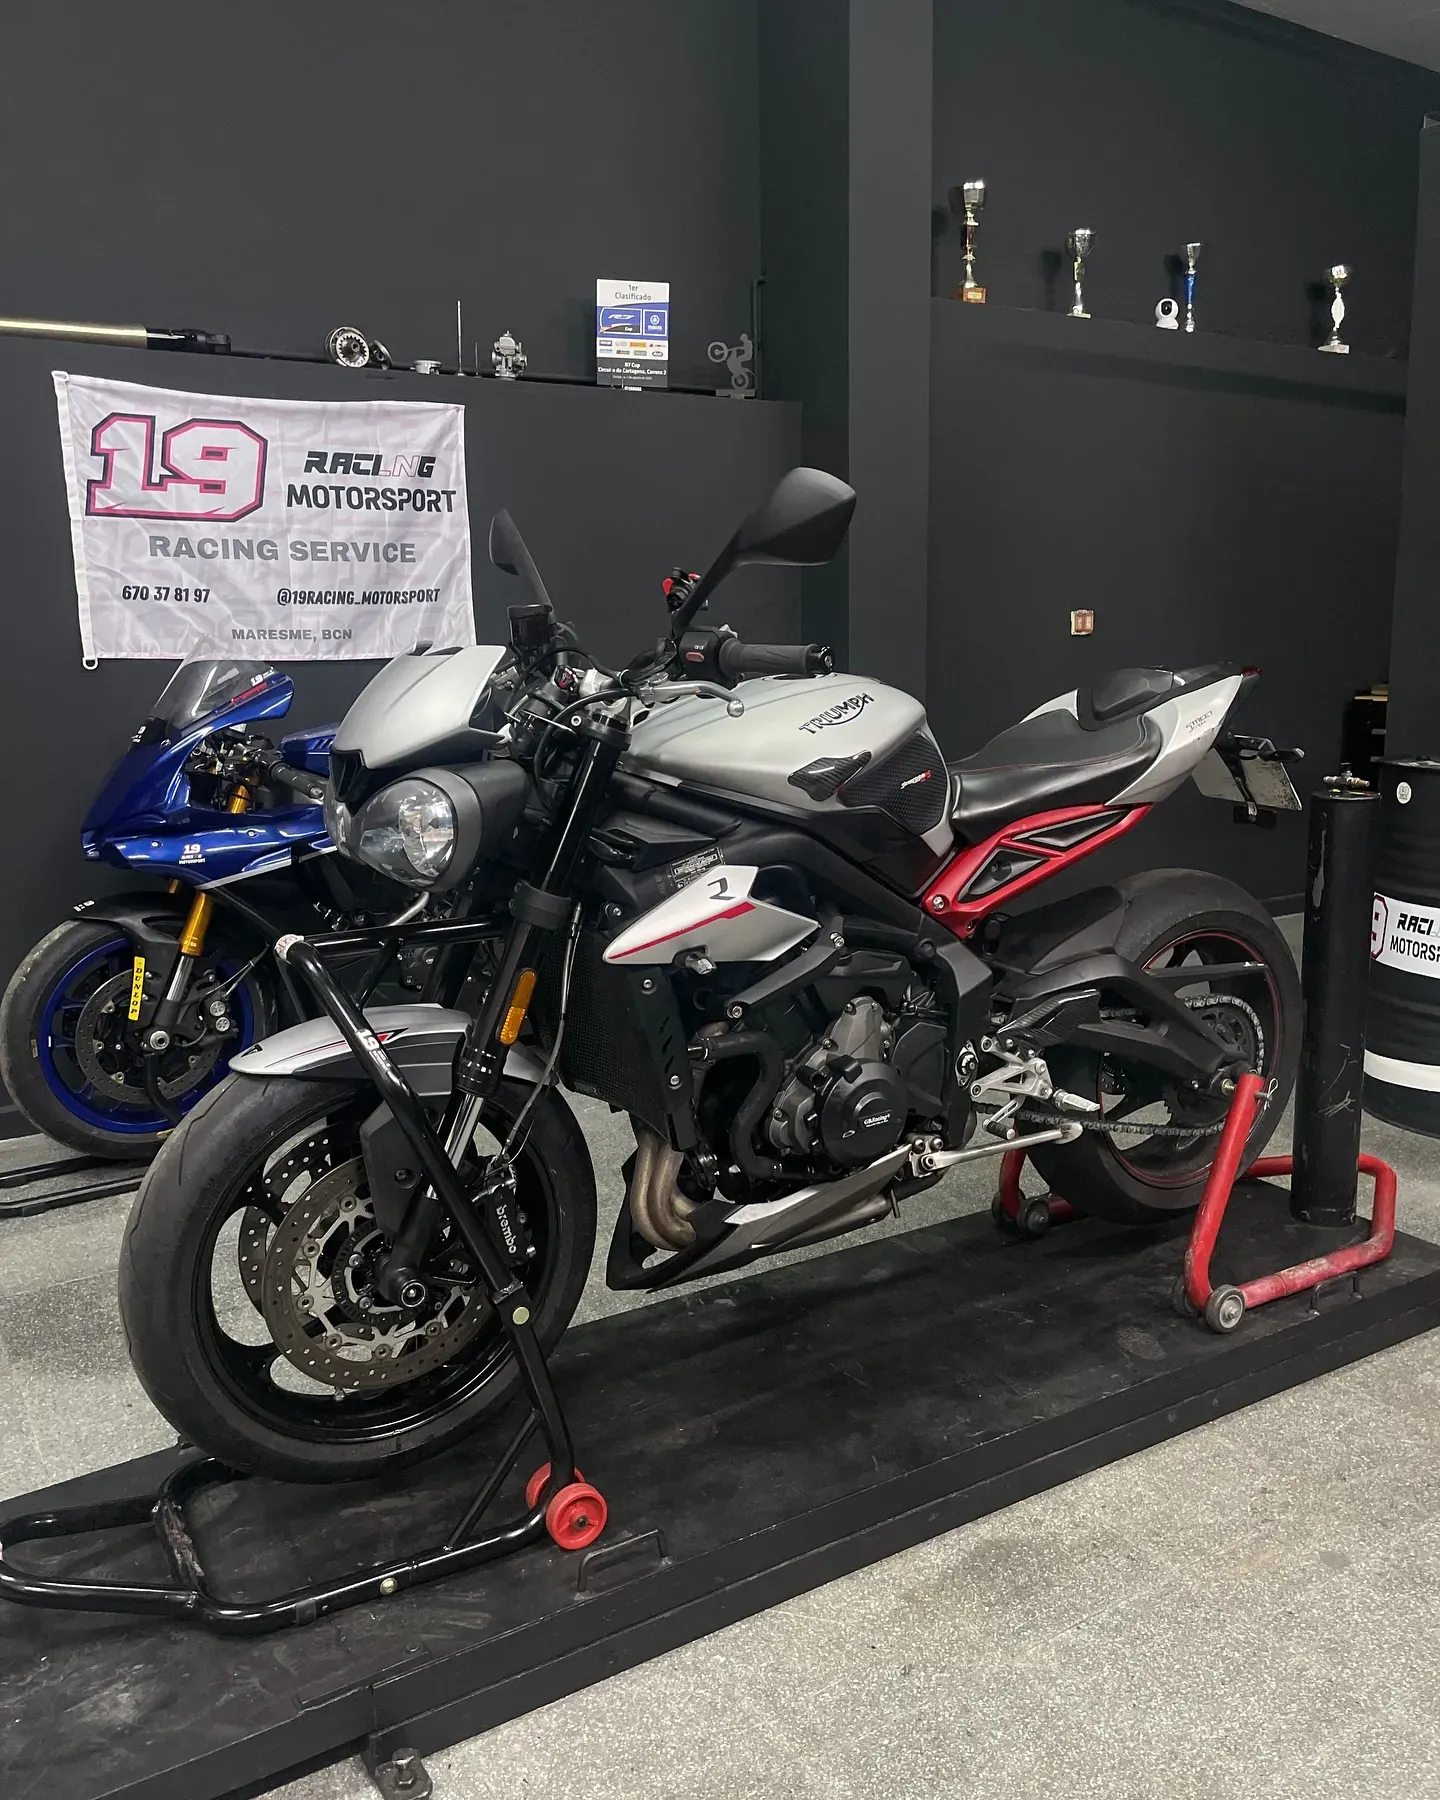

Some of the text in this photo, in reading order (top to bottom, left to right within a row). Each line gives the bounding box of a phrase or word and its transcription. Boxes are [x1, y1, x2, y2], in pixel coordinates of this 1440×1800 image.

[614, 291, 652, 301] Clasificado
[628, 284, 639, 292] 1er
[85, 411, 269, 523] 19
[286, 483, 457, 513] MOTORSPORT
[149, 534, 417, 564] RACING SERVICE
[121, 585, 211, 603] 670 37 81 97
[276, 588, 441, 606] @19RACING_MOTORSPORT
[231, 628, 353, 642] MARESME, BCN
[799, 692, 875, 734] TRIUMPH
[183, 843, 201, 855] 19
[1396, 912, 1440, 939] RACI
[130, 967, 143, 1014] DUNLOP
[495, 1203, 517, 1254] brembo
